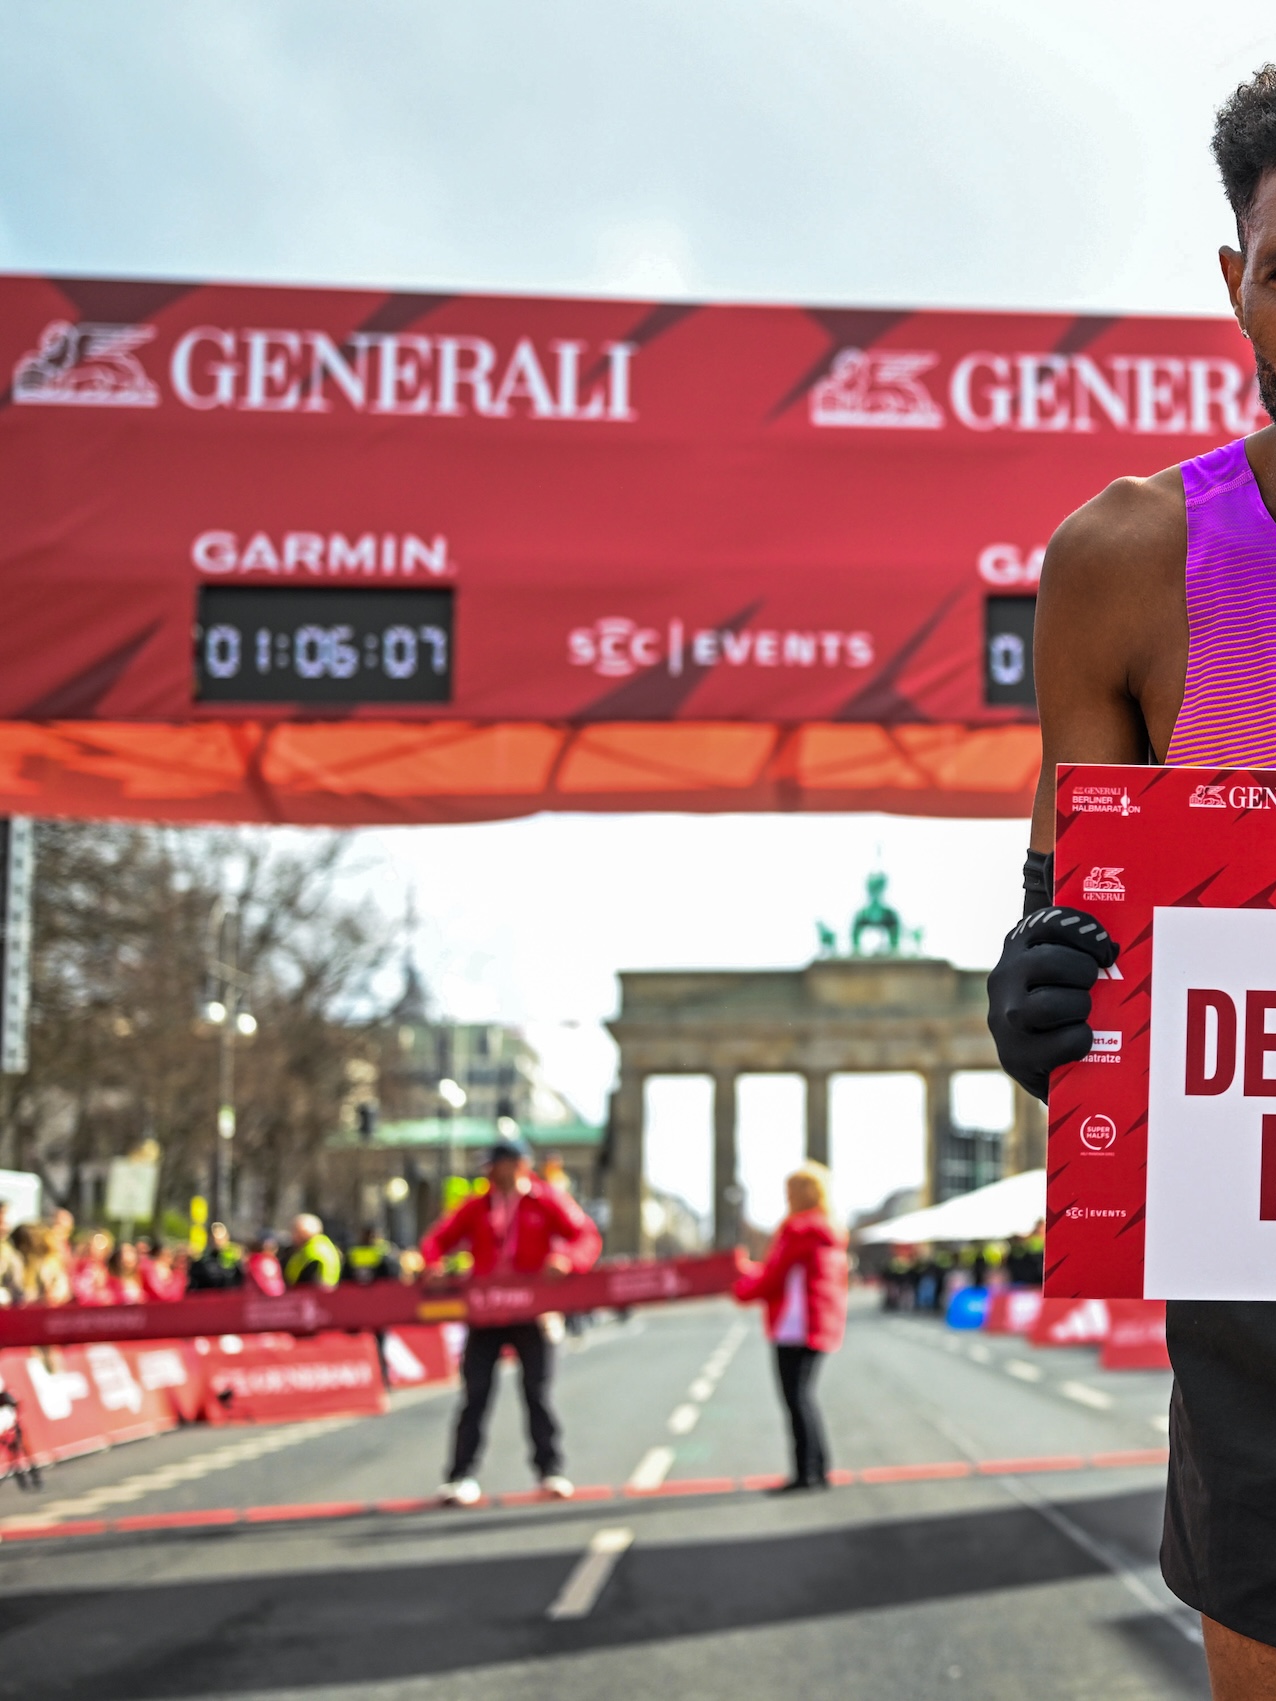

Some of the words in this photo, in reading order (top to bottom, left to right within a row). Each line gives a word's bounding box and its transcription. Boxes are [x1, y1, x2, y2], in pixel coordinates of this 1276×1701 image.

[171, 327, 639, 422] GENERALI
[951, 352, 1261, 436] GENER
[192, 531, 449, 576] GARMIN
[205, 623, 448, 679] 01:06:07
[691, 629, 875, 668] EVENTS
[1072, 796, 1113, 804] BERLINER
[1072, 805, 1141, 813] HALBMARATON
[1084, 787, 1121, 795] GENERALI
[1083, 892, 1125, 902] GENERALI
